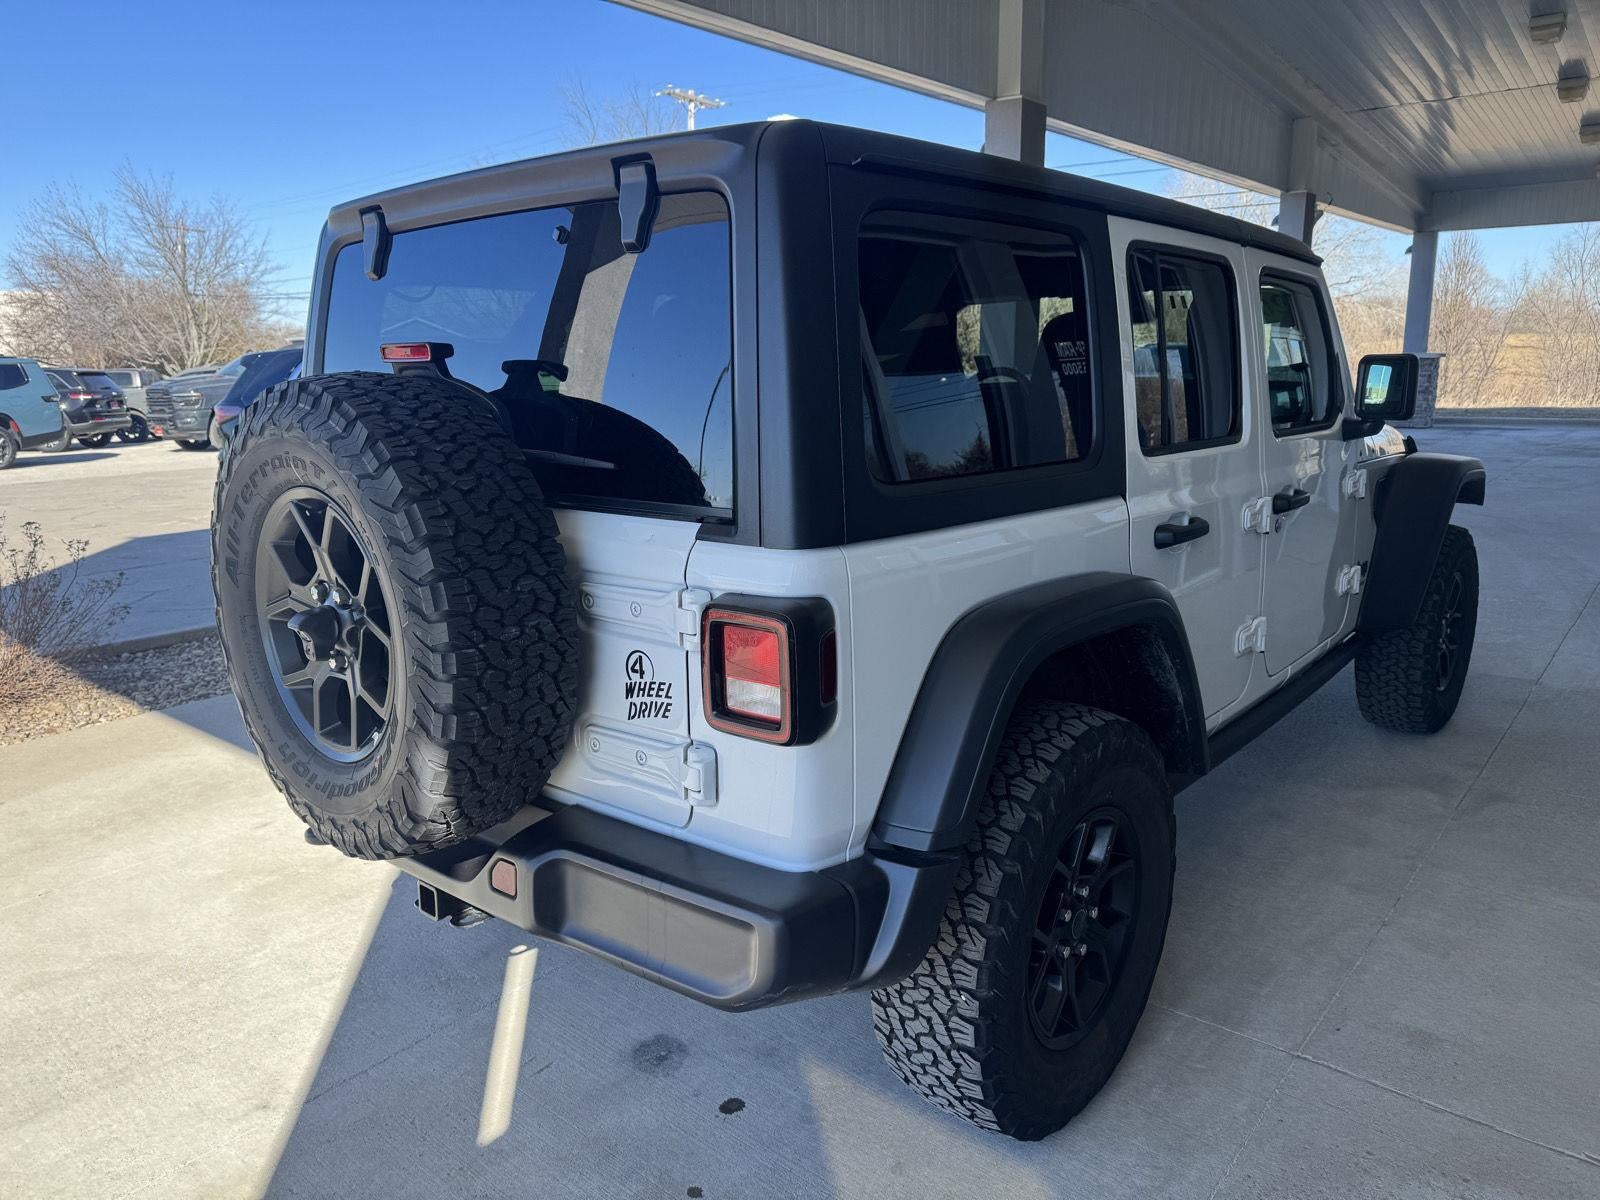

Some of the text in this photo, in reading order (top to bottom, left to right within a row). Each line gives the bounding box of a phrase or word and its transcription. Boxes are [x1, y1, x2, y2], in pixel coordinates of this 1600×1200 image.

[225, 451, 309, 588] All-Terrain
[630, 655, 645, 680] 4
[625, 681, 673, 700] WHEEL
[627, 700, 673, 721] DRIVE
[278, 703, 399, 800] BFGoodrich
